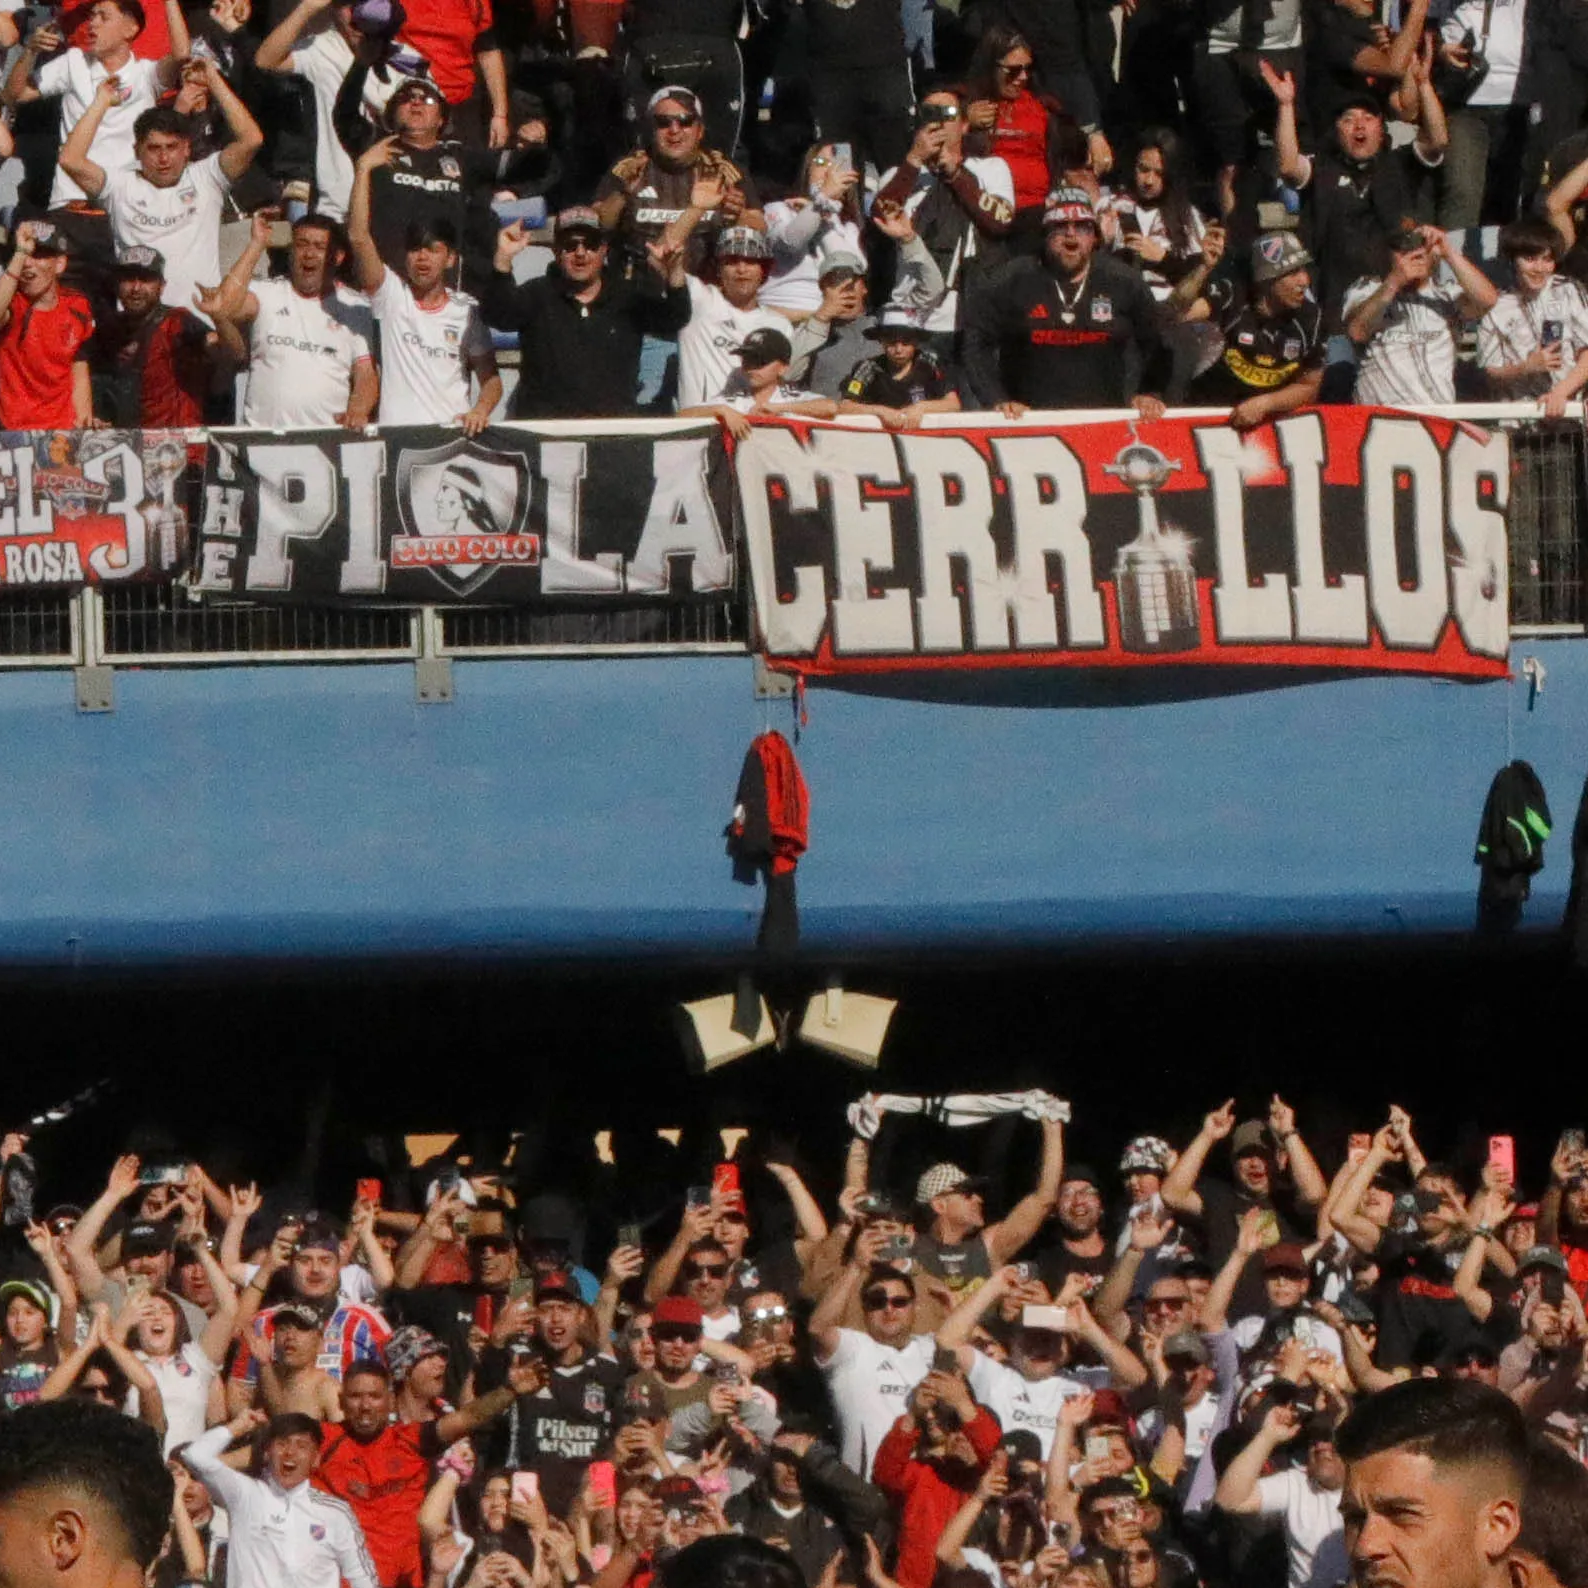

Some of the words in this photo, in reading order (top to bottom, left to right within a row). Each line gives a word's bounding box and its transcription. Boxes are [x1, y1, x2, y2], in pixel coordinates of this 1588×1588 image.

[393, 172, 452, 193] COOLBET
[266, 335, 324, 356] COOLBET
[735, 413, 1510, 657] CERRLLOS
[5, 541, 85, 584] ROSA
[536, 1417, 599, 1442] Pilsen
